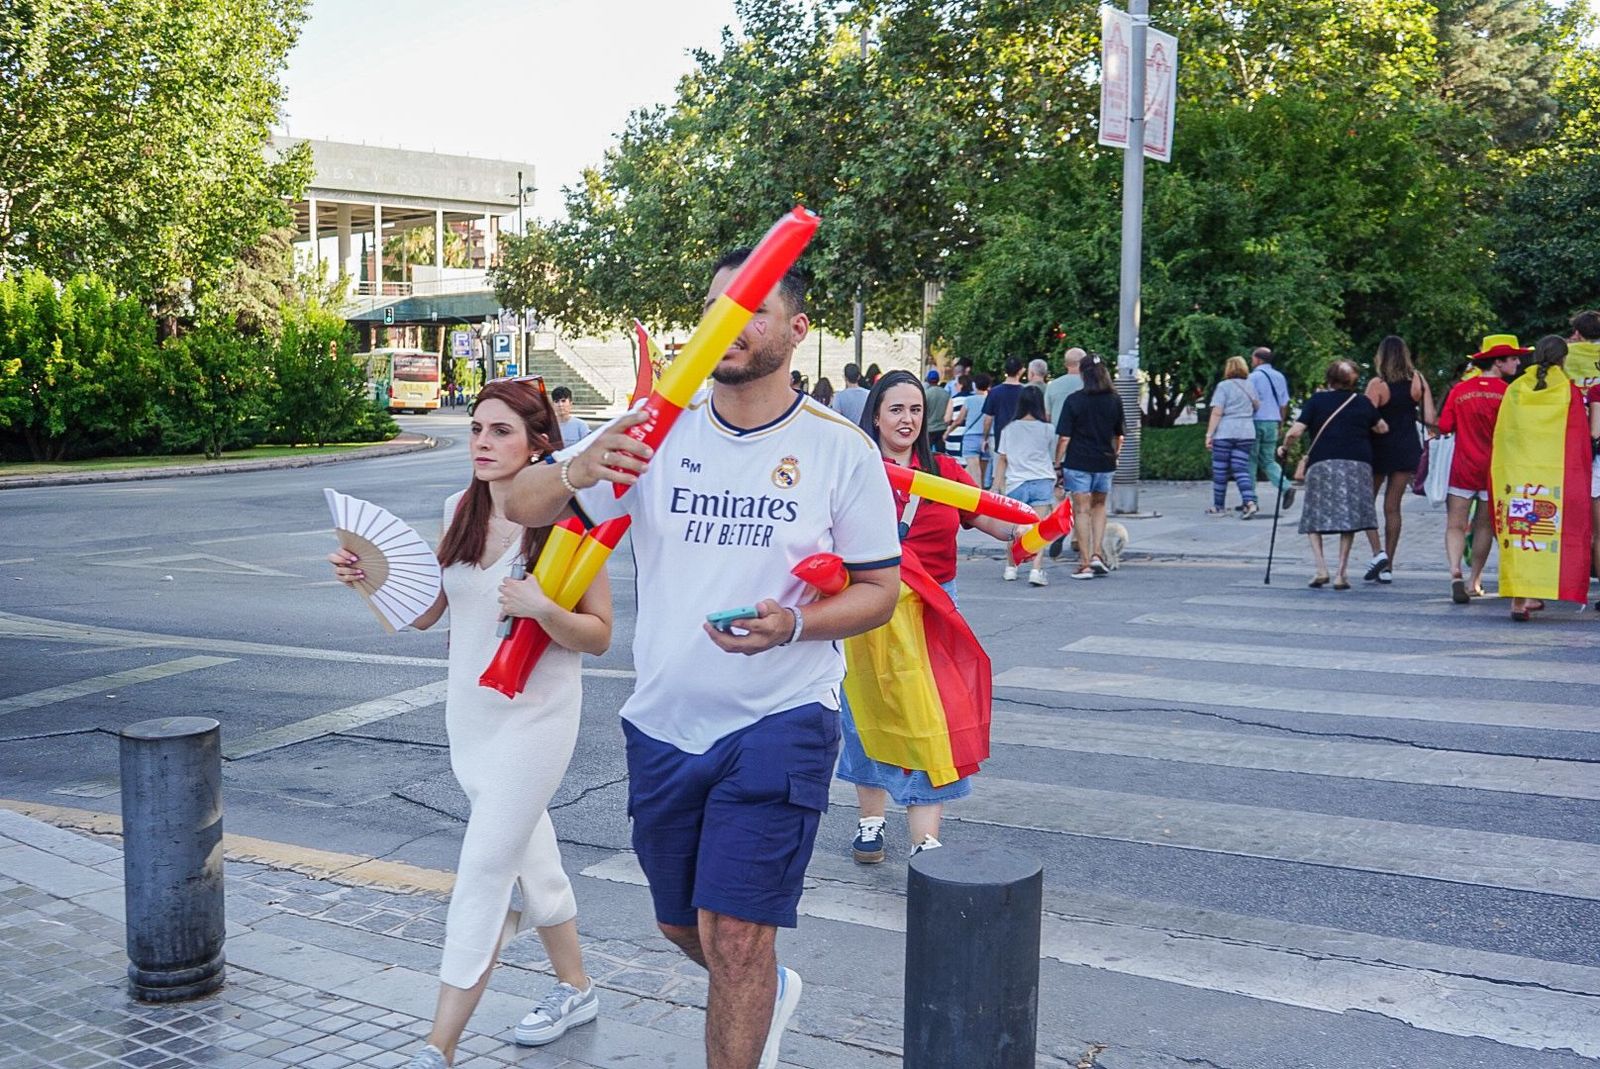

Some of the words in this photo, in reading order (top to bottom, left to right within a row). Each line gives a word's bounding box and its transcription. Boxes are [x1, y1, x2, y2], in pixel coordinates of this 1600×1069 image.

[495, 335, 509, 352] P
[400, 383, 430, 392] ALSA
[670, 487, 798, 522] Emirates
[684, 520, 714, 543] FLY
[718, 524, 774, 548] BETTER
